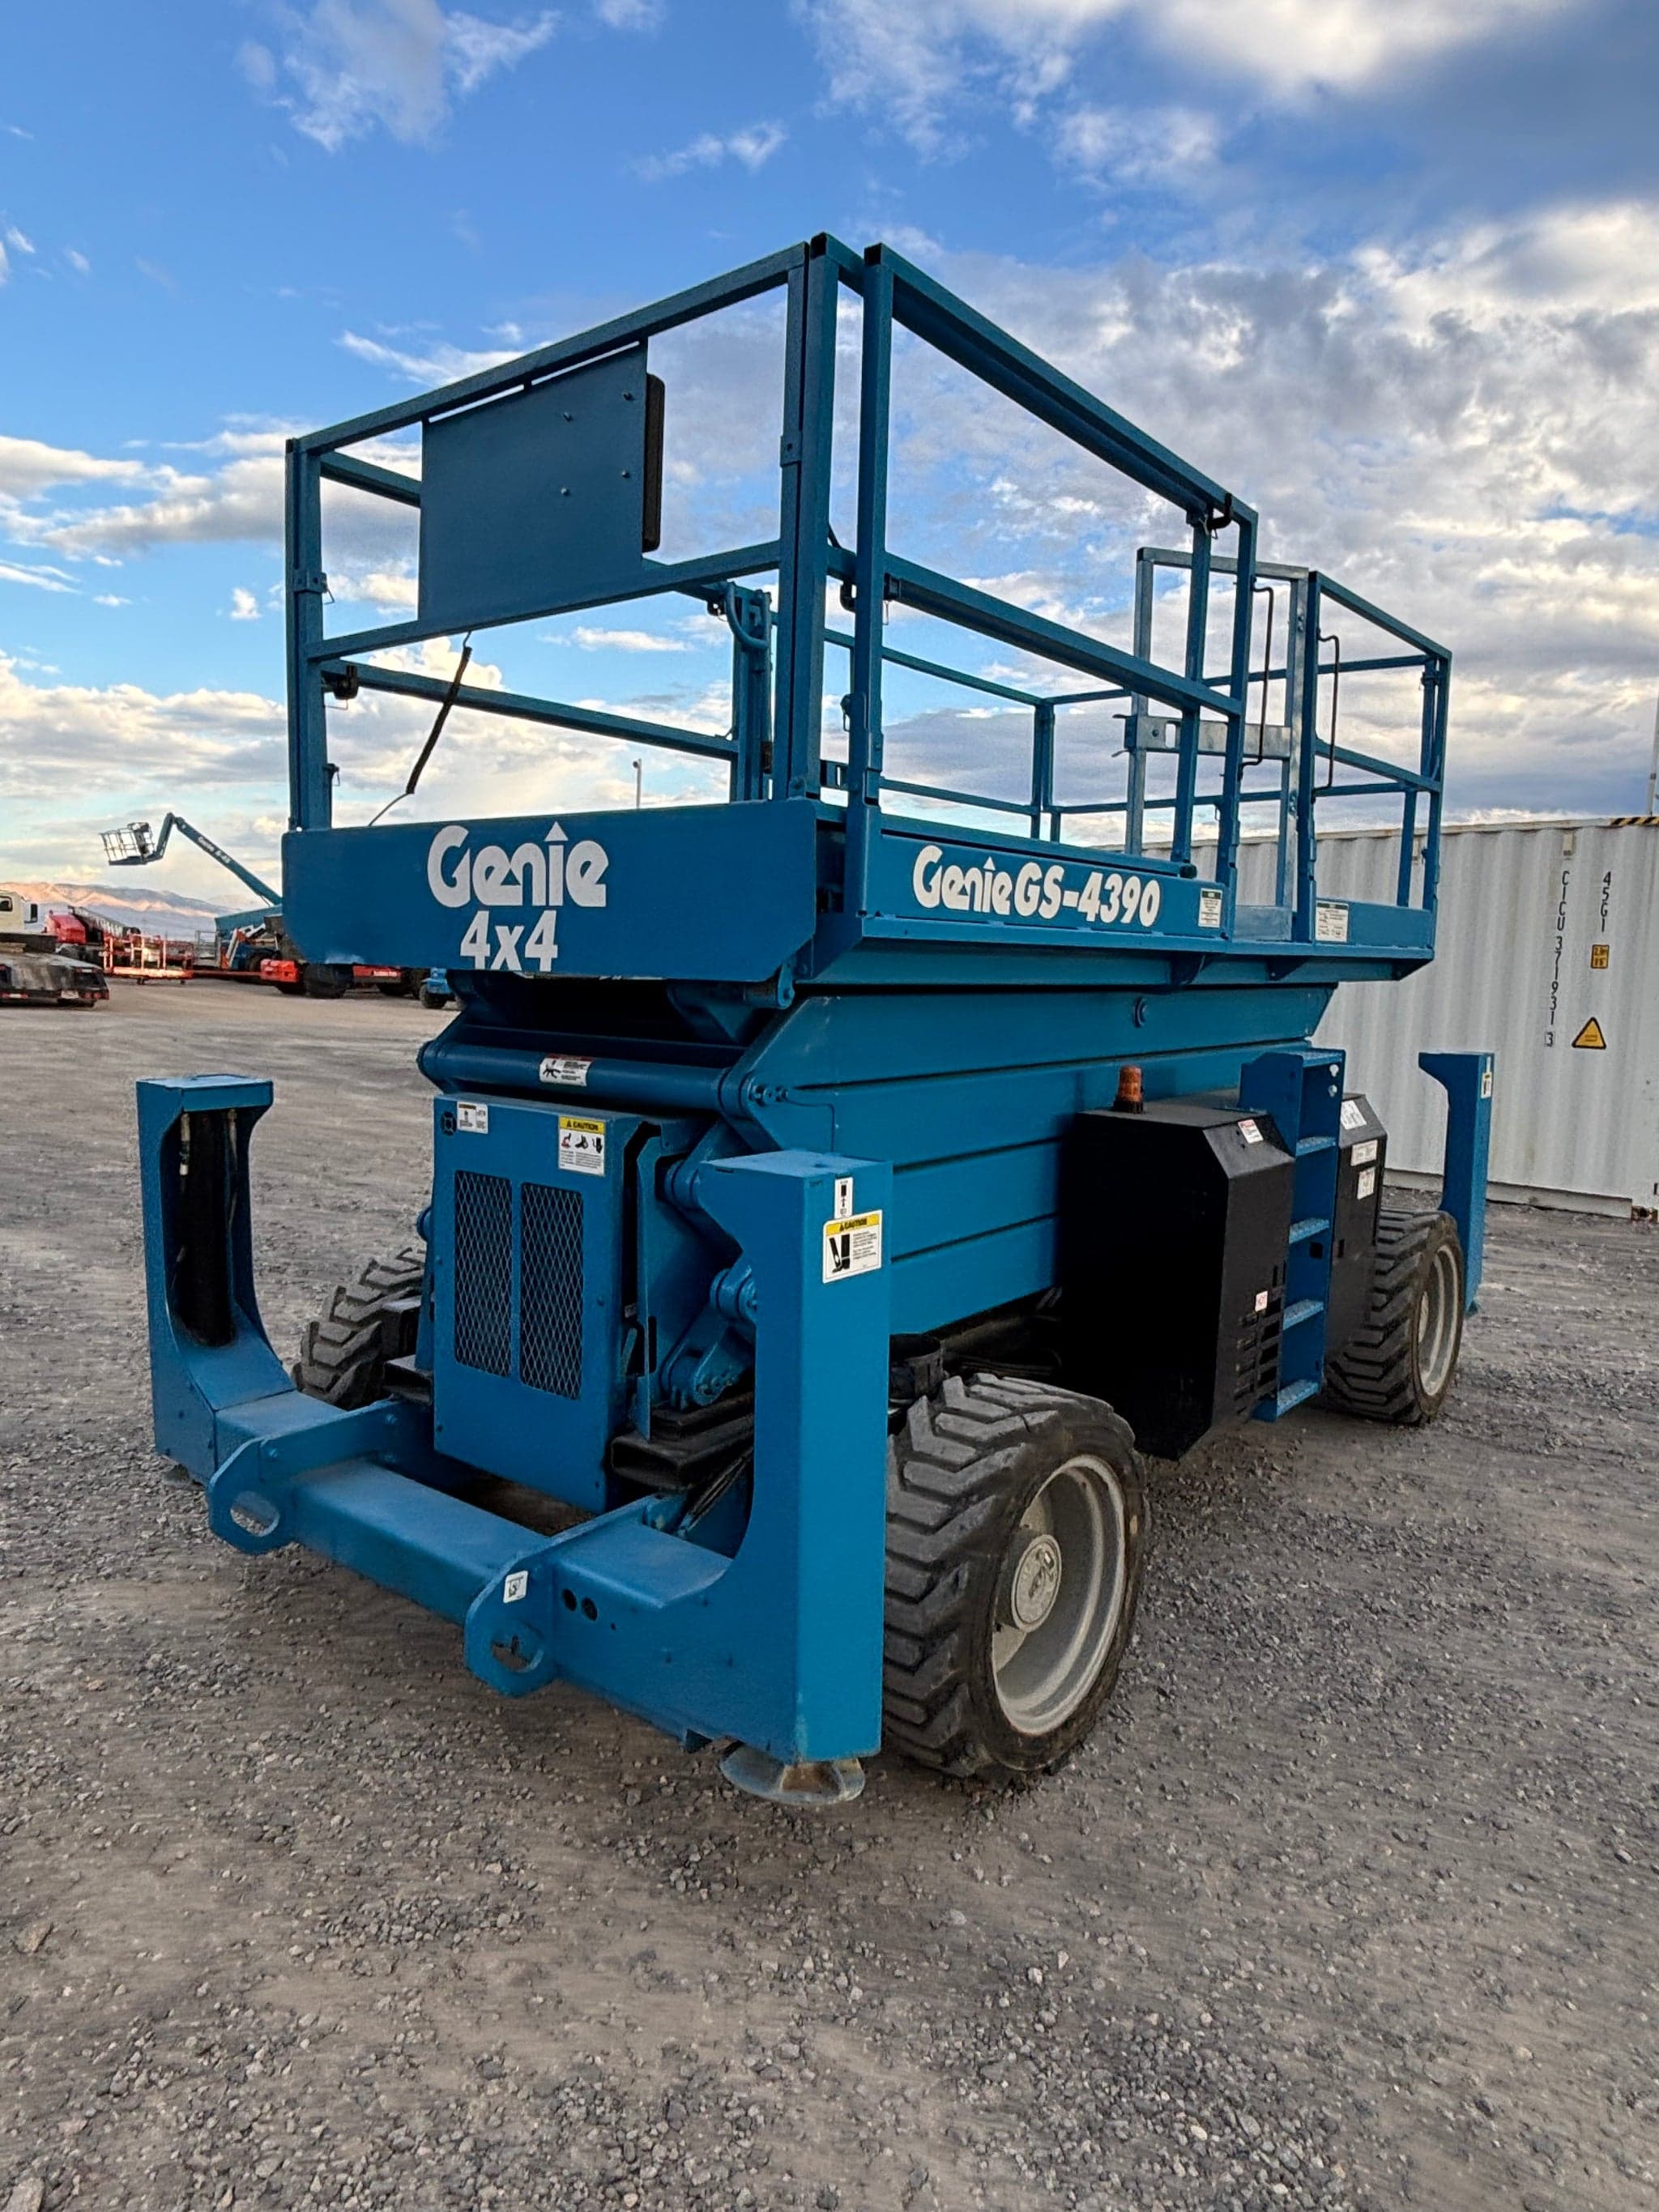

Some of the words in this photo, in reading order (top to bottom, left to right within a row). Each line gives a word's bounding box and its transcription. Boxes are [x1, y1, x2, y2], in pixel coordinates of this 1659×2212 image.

[427, 820, 609, 908] Genie
[913, 845, 1013, 916] Genie
[1013, 862, 1161, 927] GS-4390
[460, 910, 558, 972] 4x4
[573, 1120, 599, 1132] CAUTION
[844, 1217, 868, 1230] CAUTION
